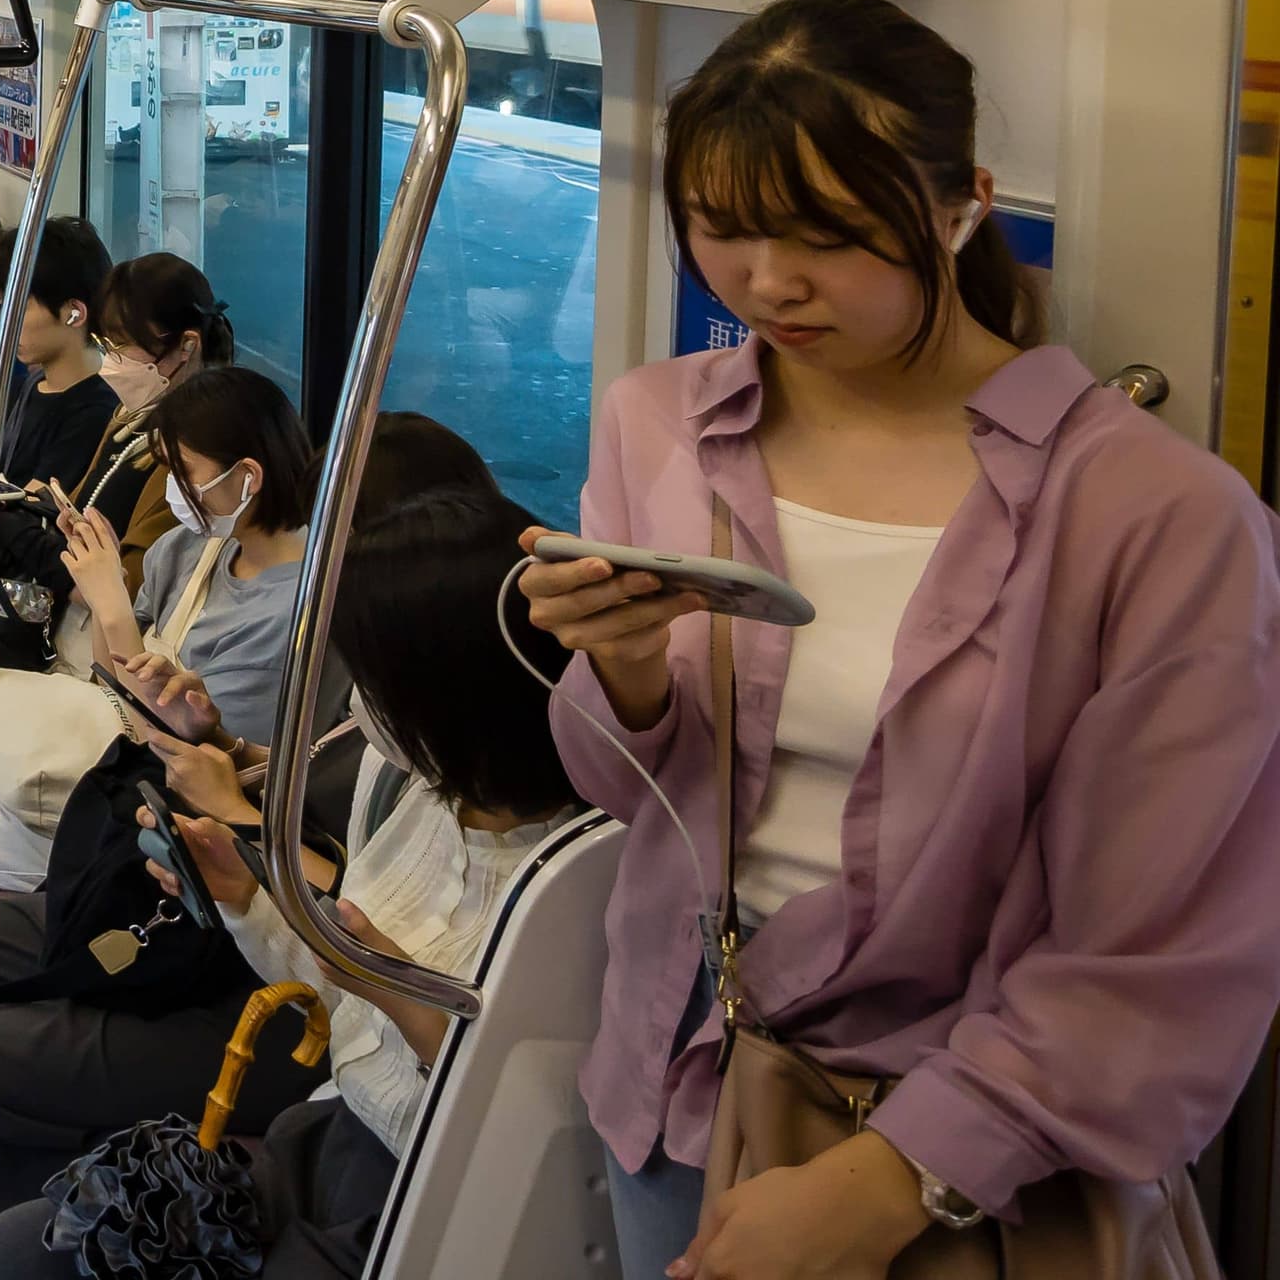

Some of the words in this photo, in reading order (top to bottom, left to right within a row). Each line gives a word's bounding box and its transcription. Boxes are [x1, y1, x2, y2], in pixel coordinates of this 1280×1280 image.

[146, 47, 158, 120] なかの
[230, 64, 281, 78] acure
